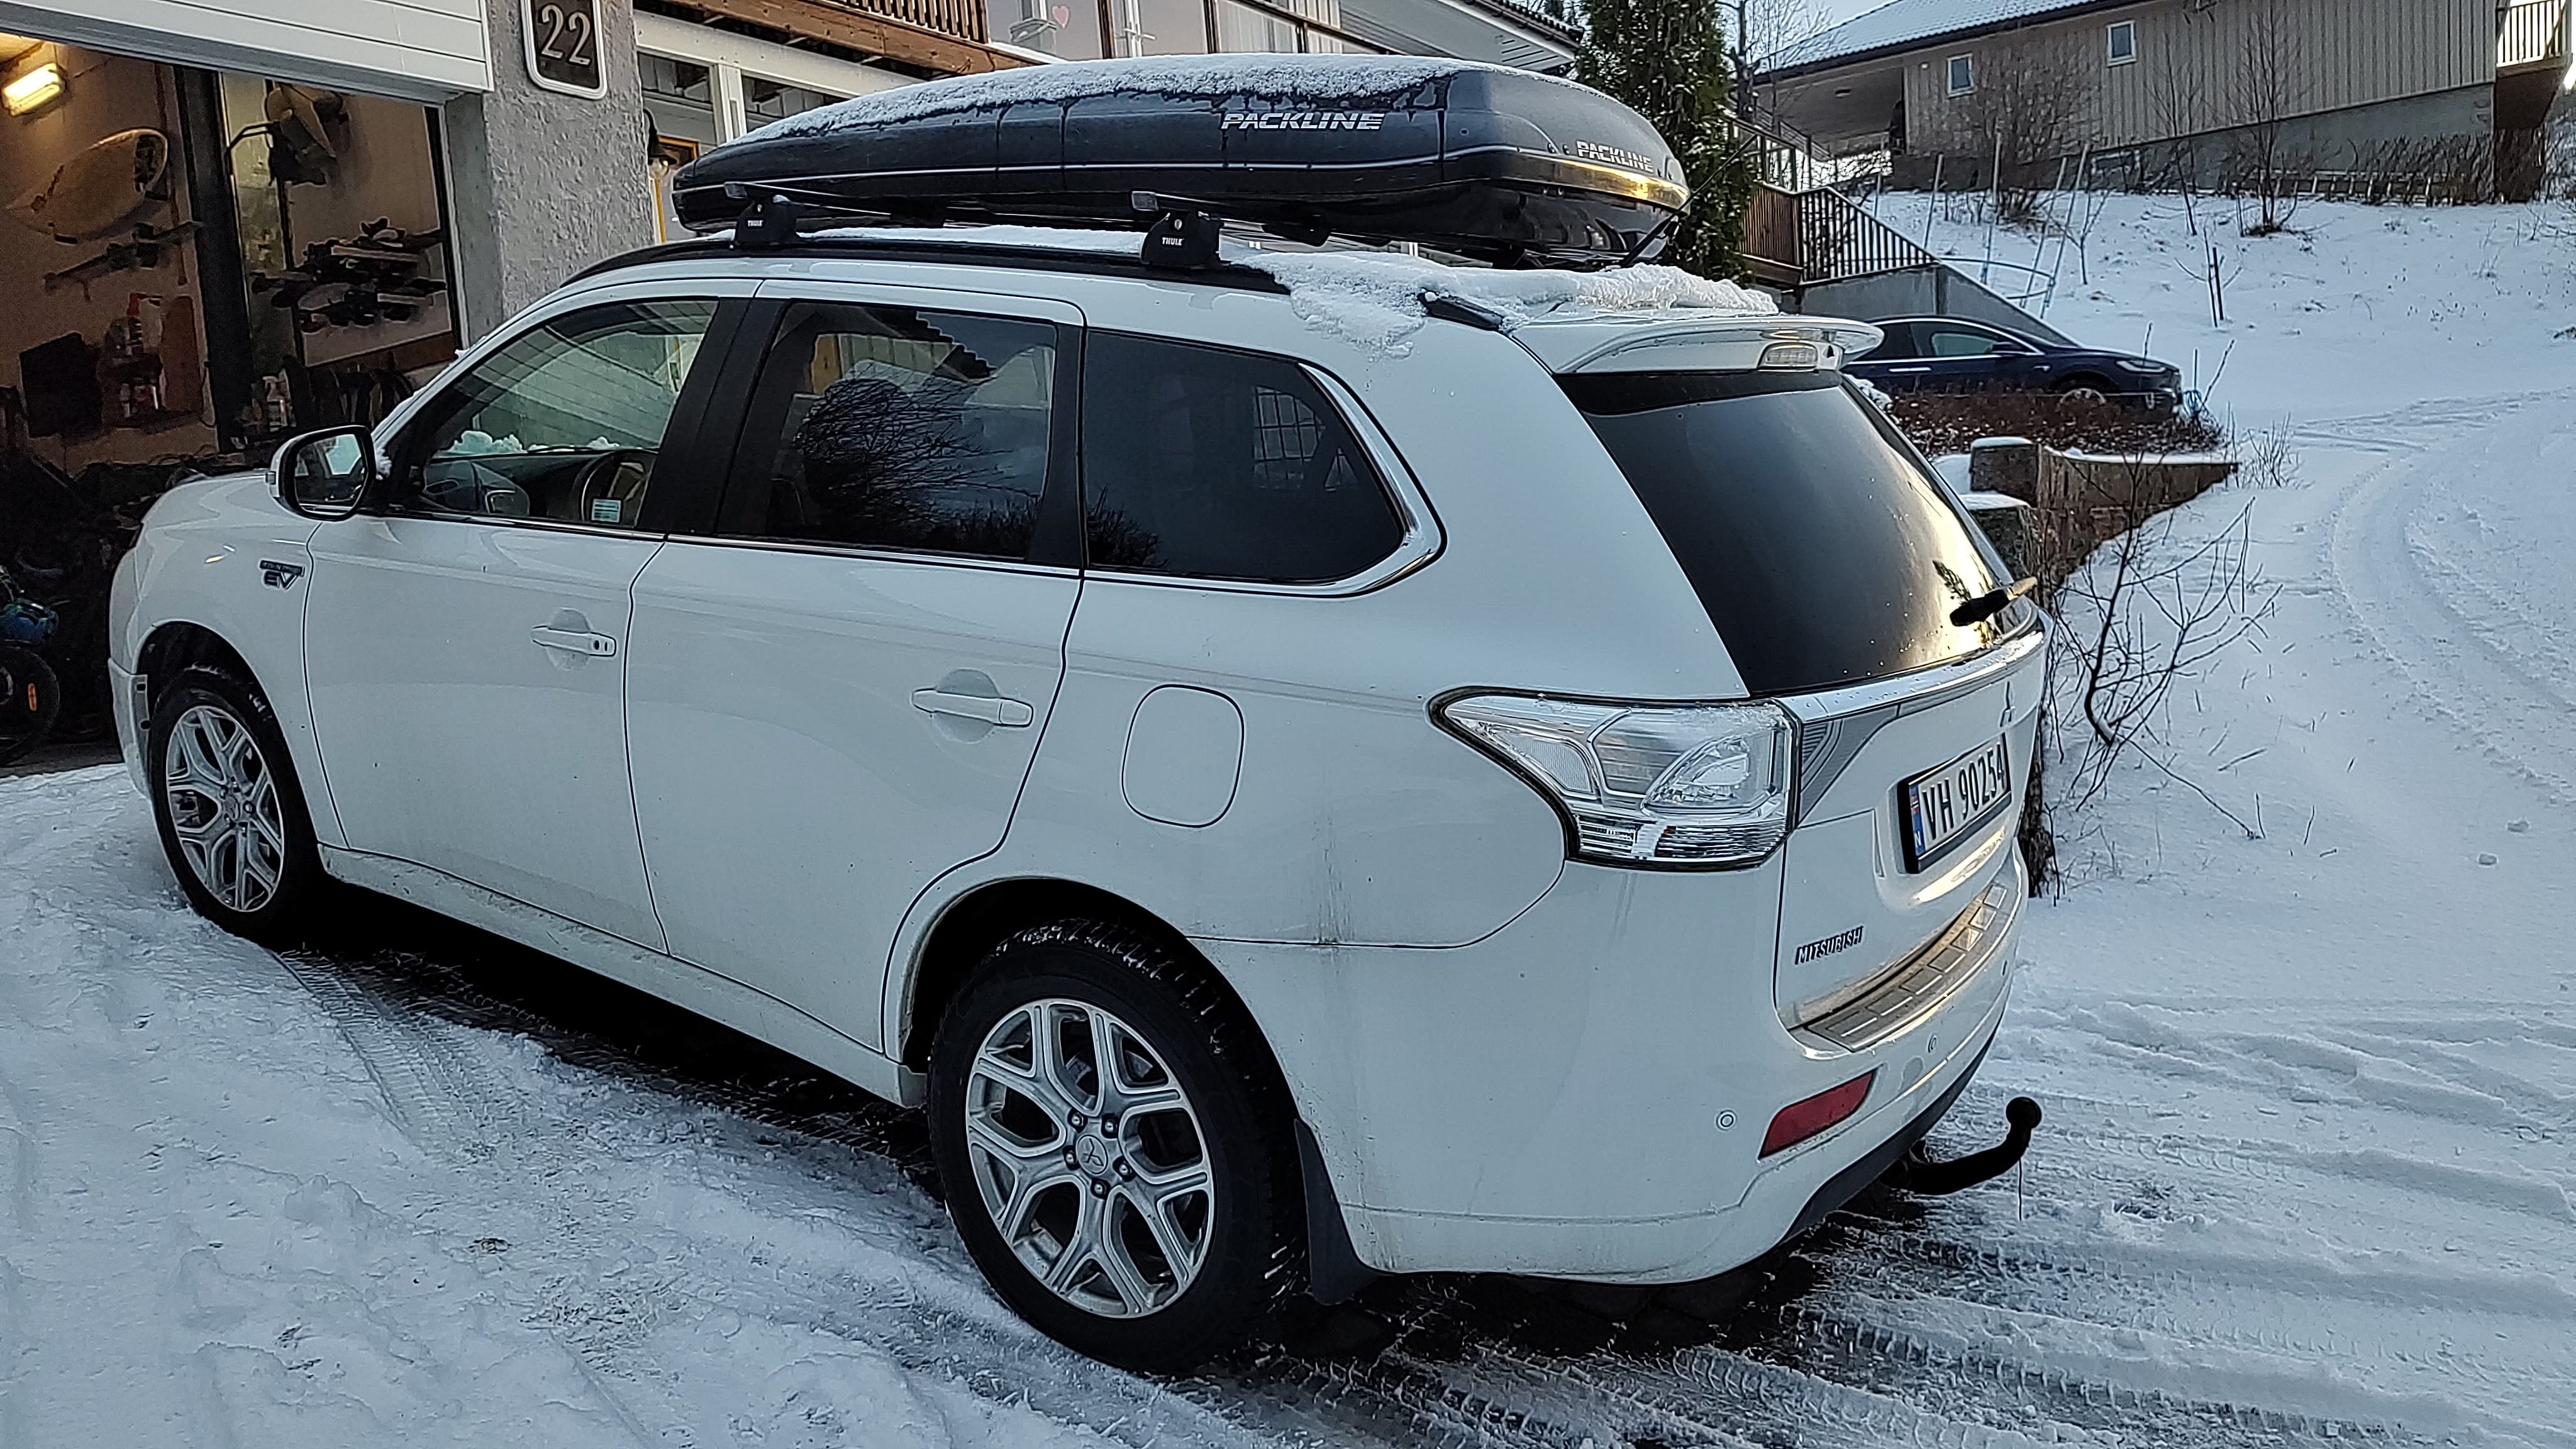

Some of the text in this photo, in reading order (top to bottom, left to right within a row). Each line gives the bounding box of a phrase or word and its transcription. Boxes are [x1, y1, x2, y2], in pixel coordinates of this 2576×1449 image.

[541, 4, 591, 65] 22
[1221, 113, 1385, 130] PACKLINE
[1577, 140, 1653, 172] PACKLINE
[1162, 236, 1184, 246] THULE
[1922, 741, 2004, 840] VH 90254
[1914, 830, 1922, 847] N
